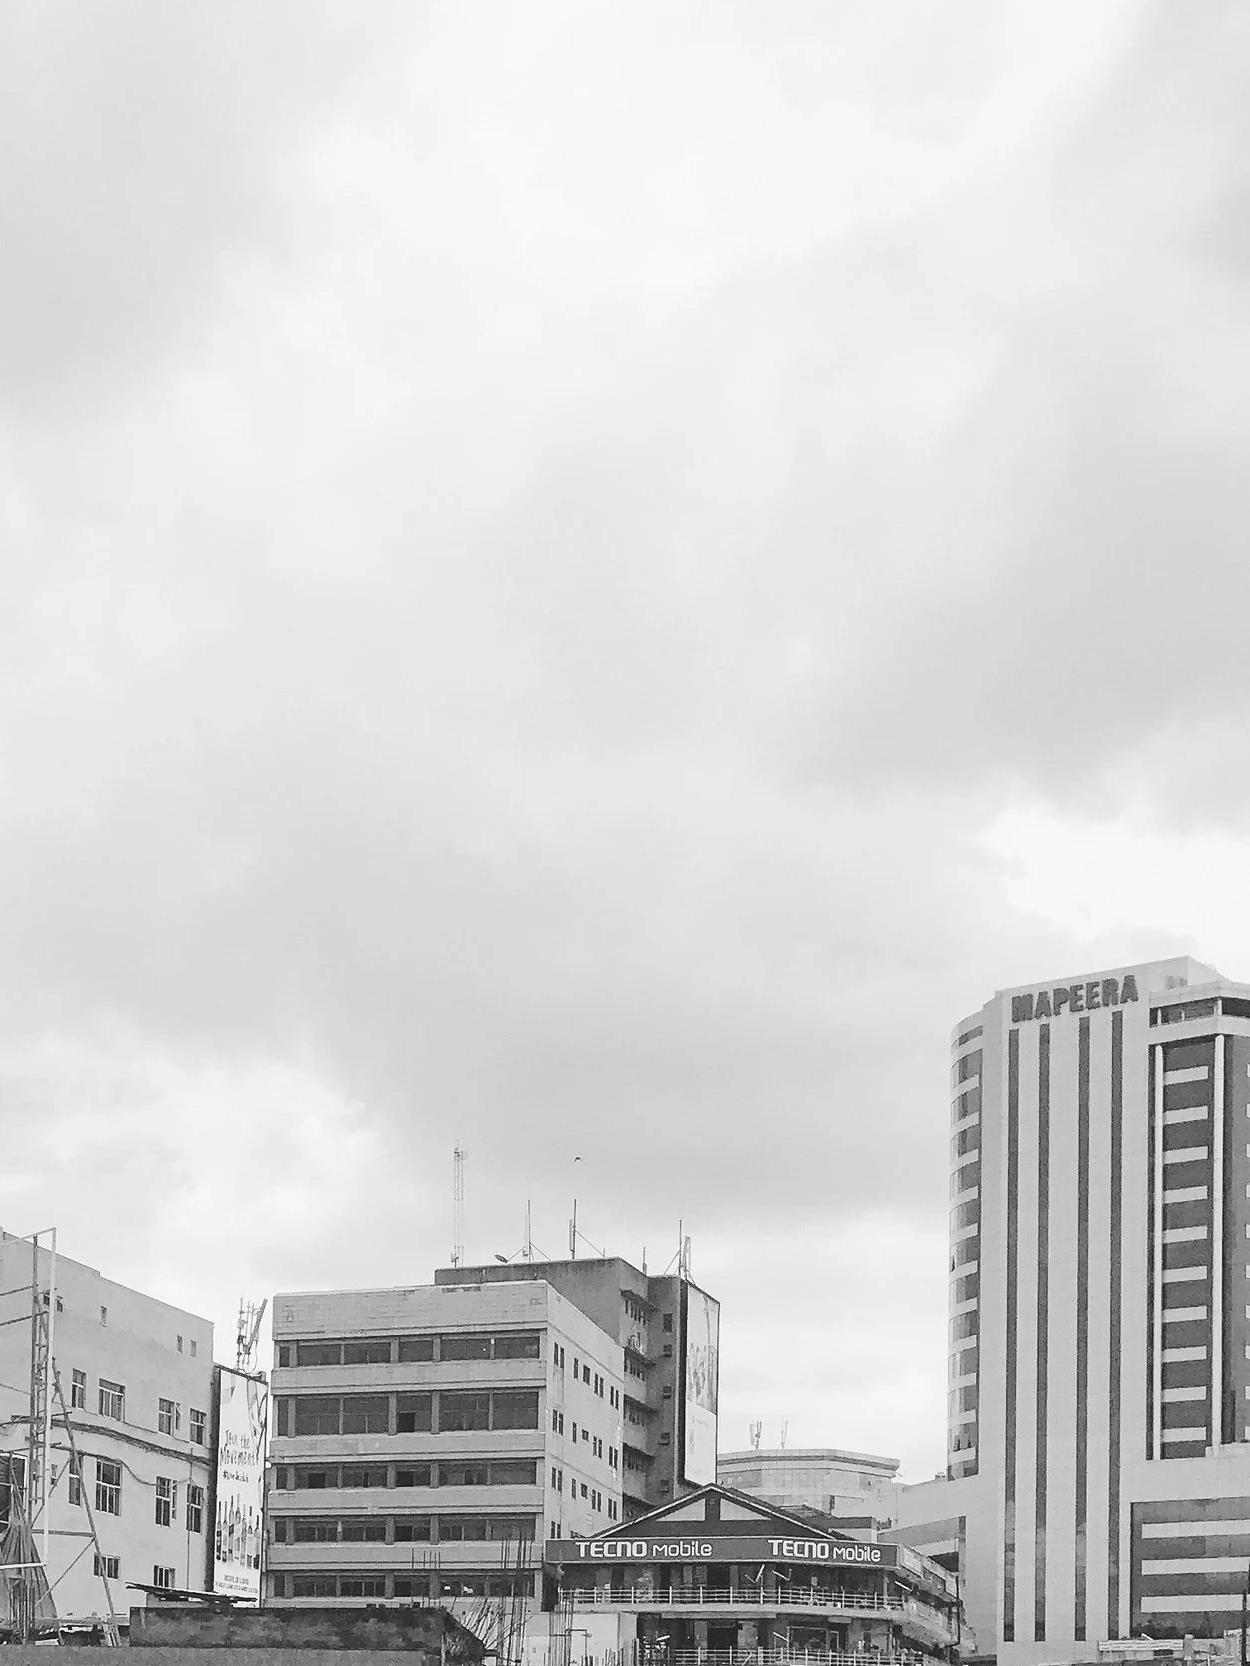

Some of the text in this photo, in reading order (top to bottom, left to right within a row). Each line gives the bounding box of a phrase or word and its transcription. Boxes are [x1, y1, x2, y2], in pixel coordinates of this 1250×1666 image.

[1011, 974, 1139, 1023] MAPEERA
[575, 1541, 647, 1557] TECNO
[768, 1539, 829, 1558] TECNO
